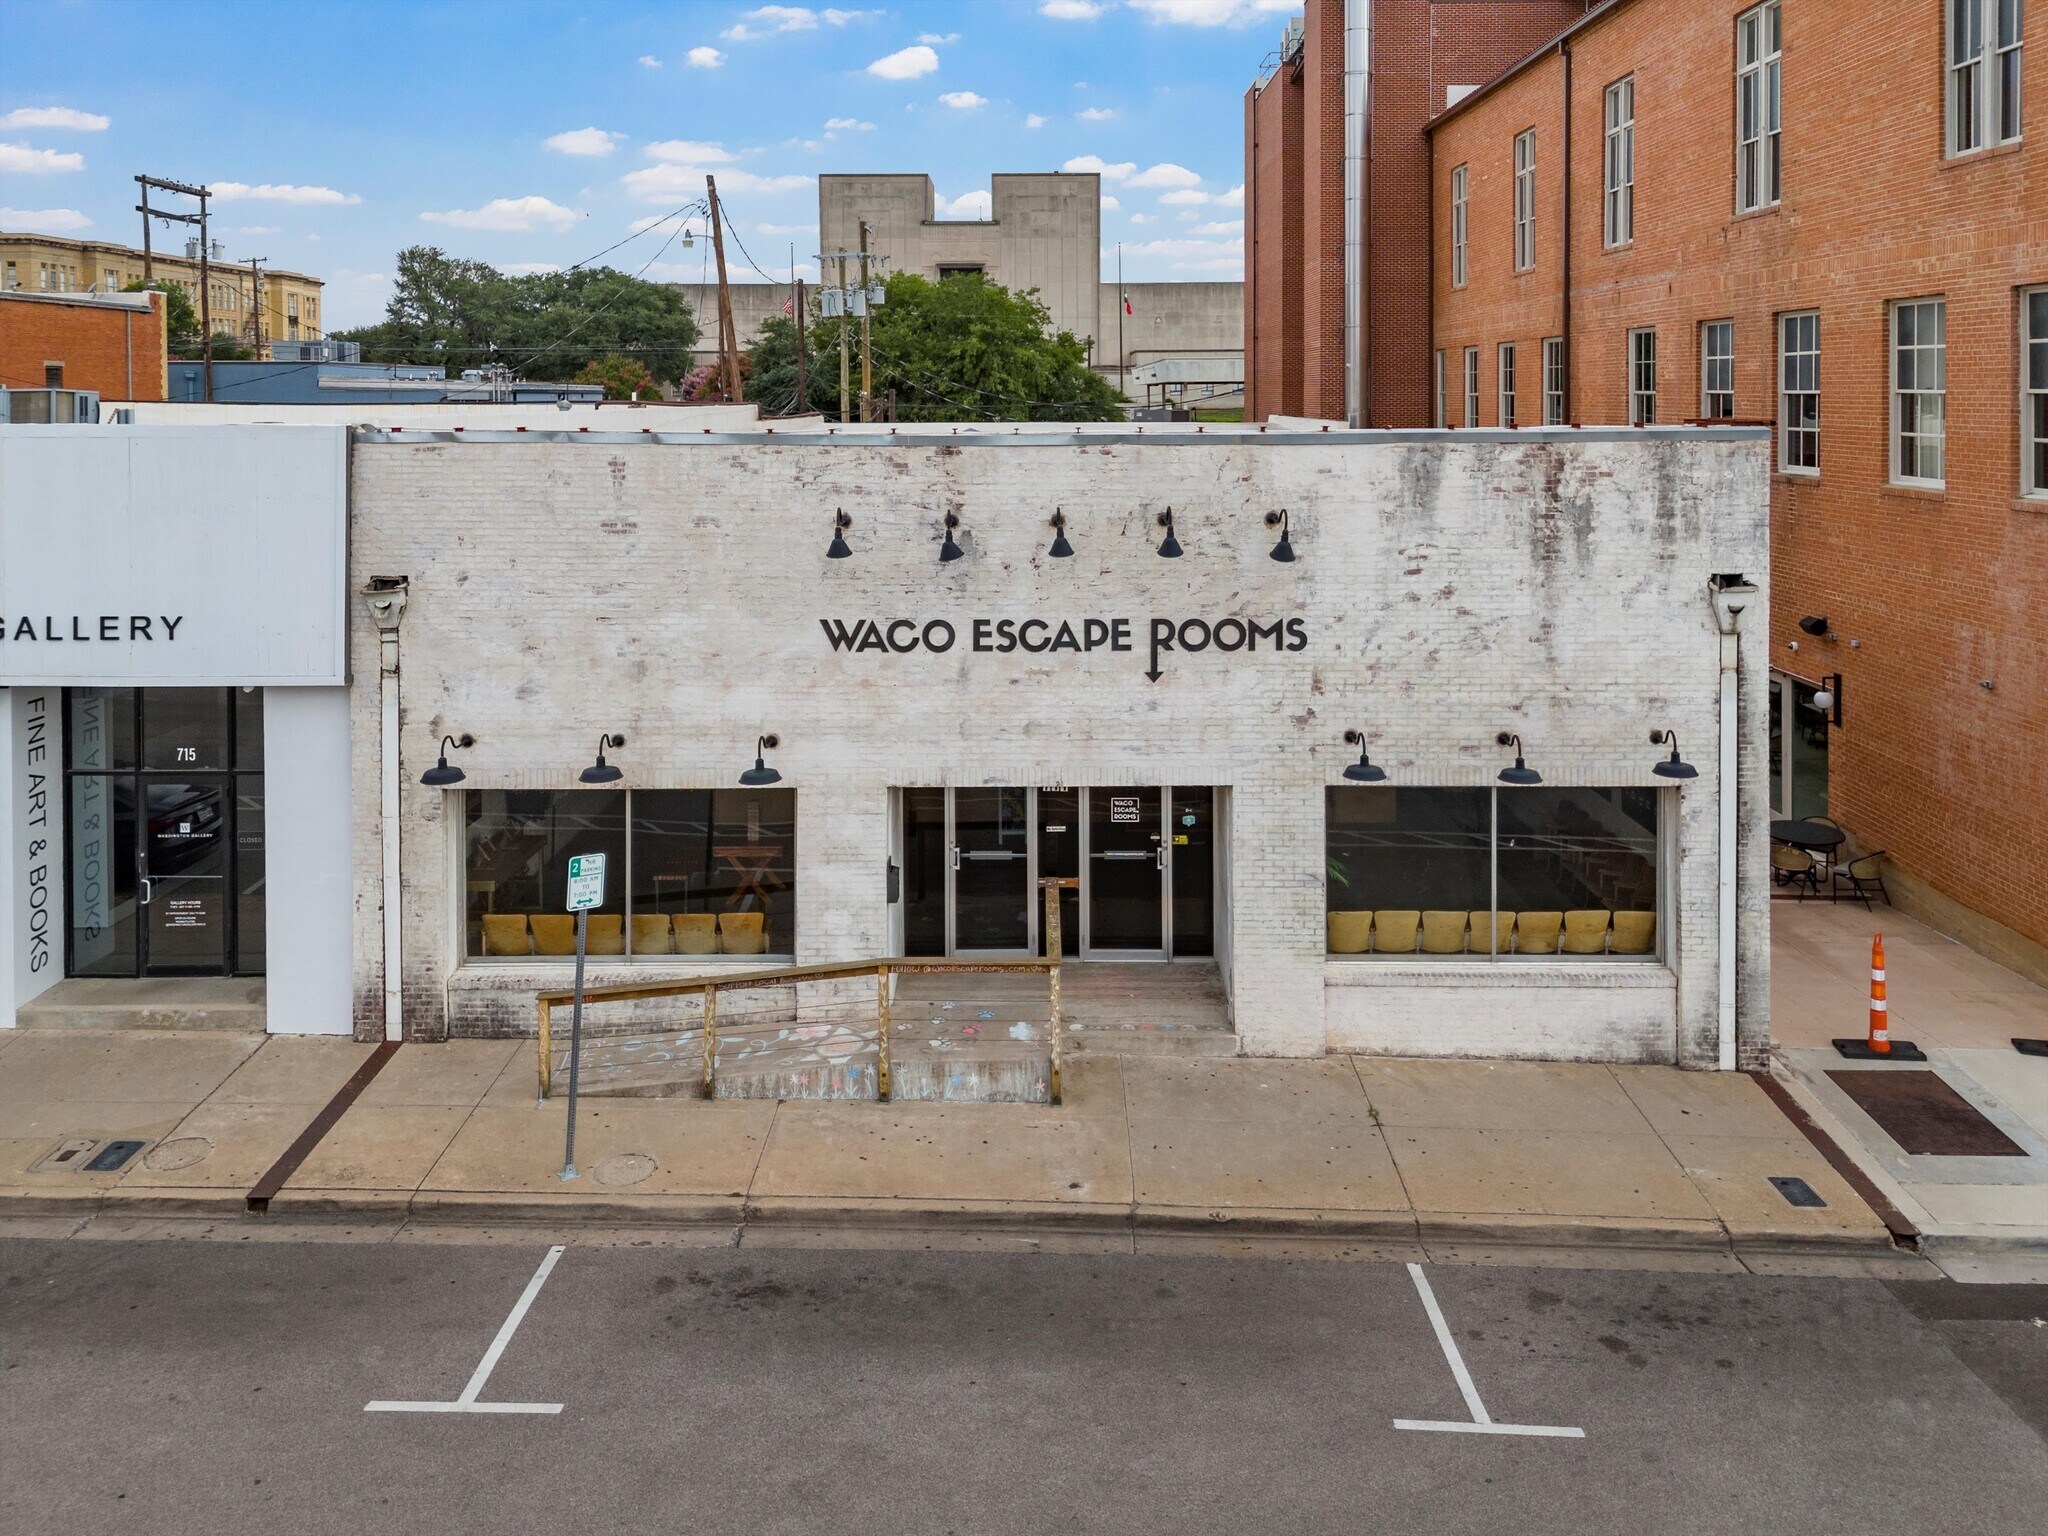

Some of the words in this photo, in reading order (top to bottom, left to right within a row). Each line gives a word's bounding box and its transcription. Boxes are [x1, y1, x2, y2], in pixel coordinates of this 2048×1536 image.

[0, 616, 183, 641] ALLERY
[819, 618, 955, 653] WACO
[972, 618, 1132, 653] ESCAPE
[1149, 617, 1309, 672] ROOMS
[27, 697, 46, 766] FINE
[177, 747, 196, 761] 715
[28, 774, 47, 827] ART
[29, 839, 47, 860] &
[572, 863, 579, 873] 2
[581, 865, 601, 873] PARKING
[29, 864, 48, 973] BOOKS
